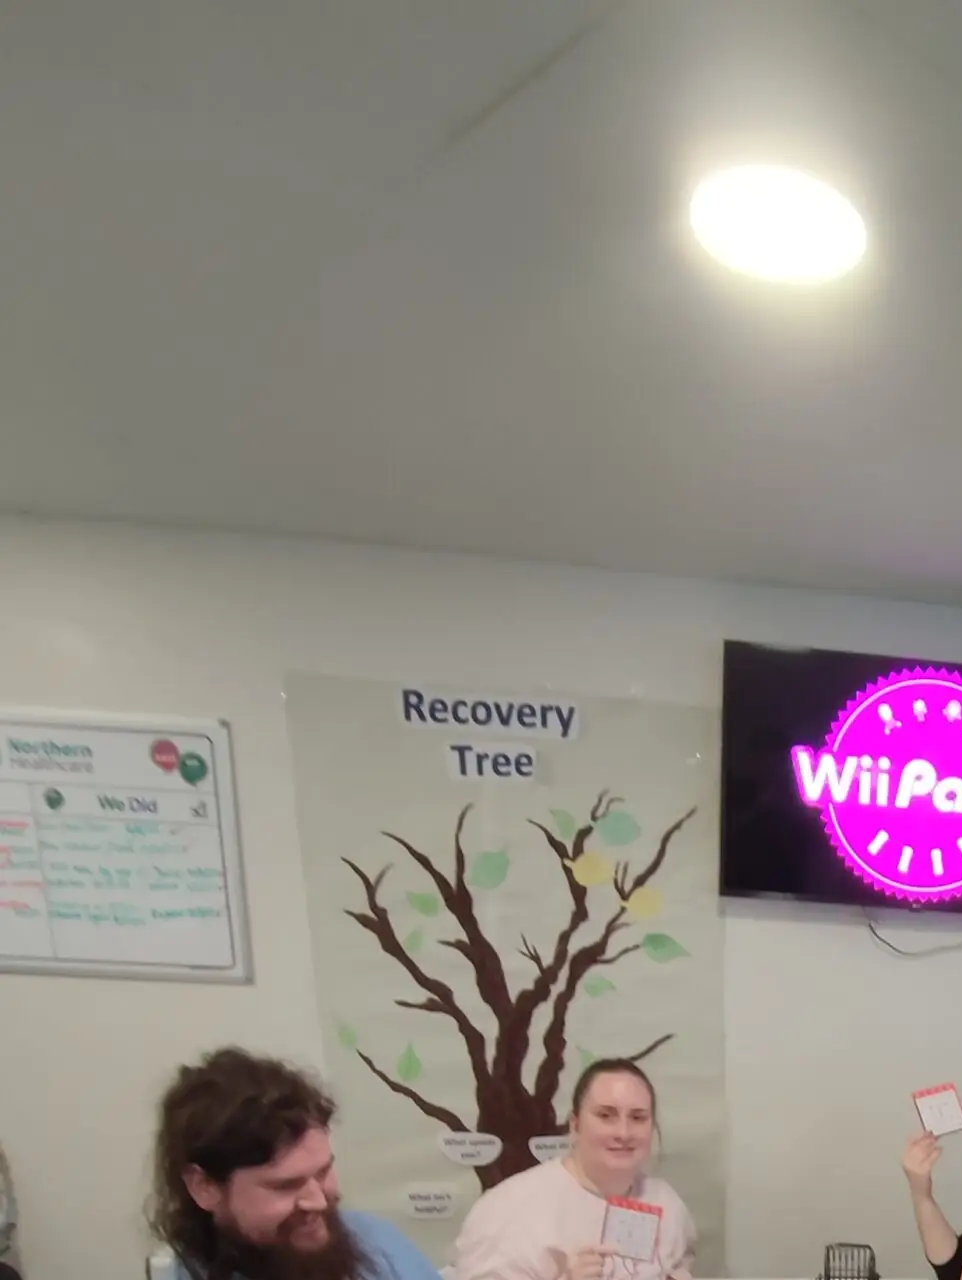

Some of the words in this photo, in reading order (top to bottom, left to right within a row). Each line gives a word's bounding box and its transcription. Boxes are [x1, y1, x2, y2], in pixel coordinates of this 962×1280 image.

[403, 689, 575, 738] Recovery
[8, 738, 93, 757] Northern
[450, 745, 533, 777] Tree
[796, 750, 892, 807] Wii
[97, 795, 125, 812] We
[127, 797, 157, 814] Did
